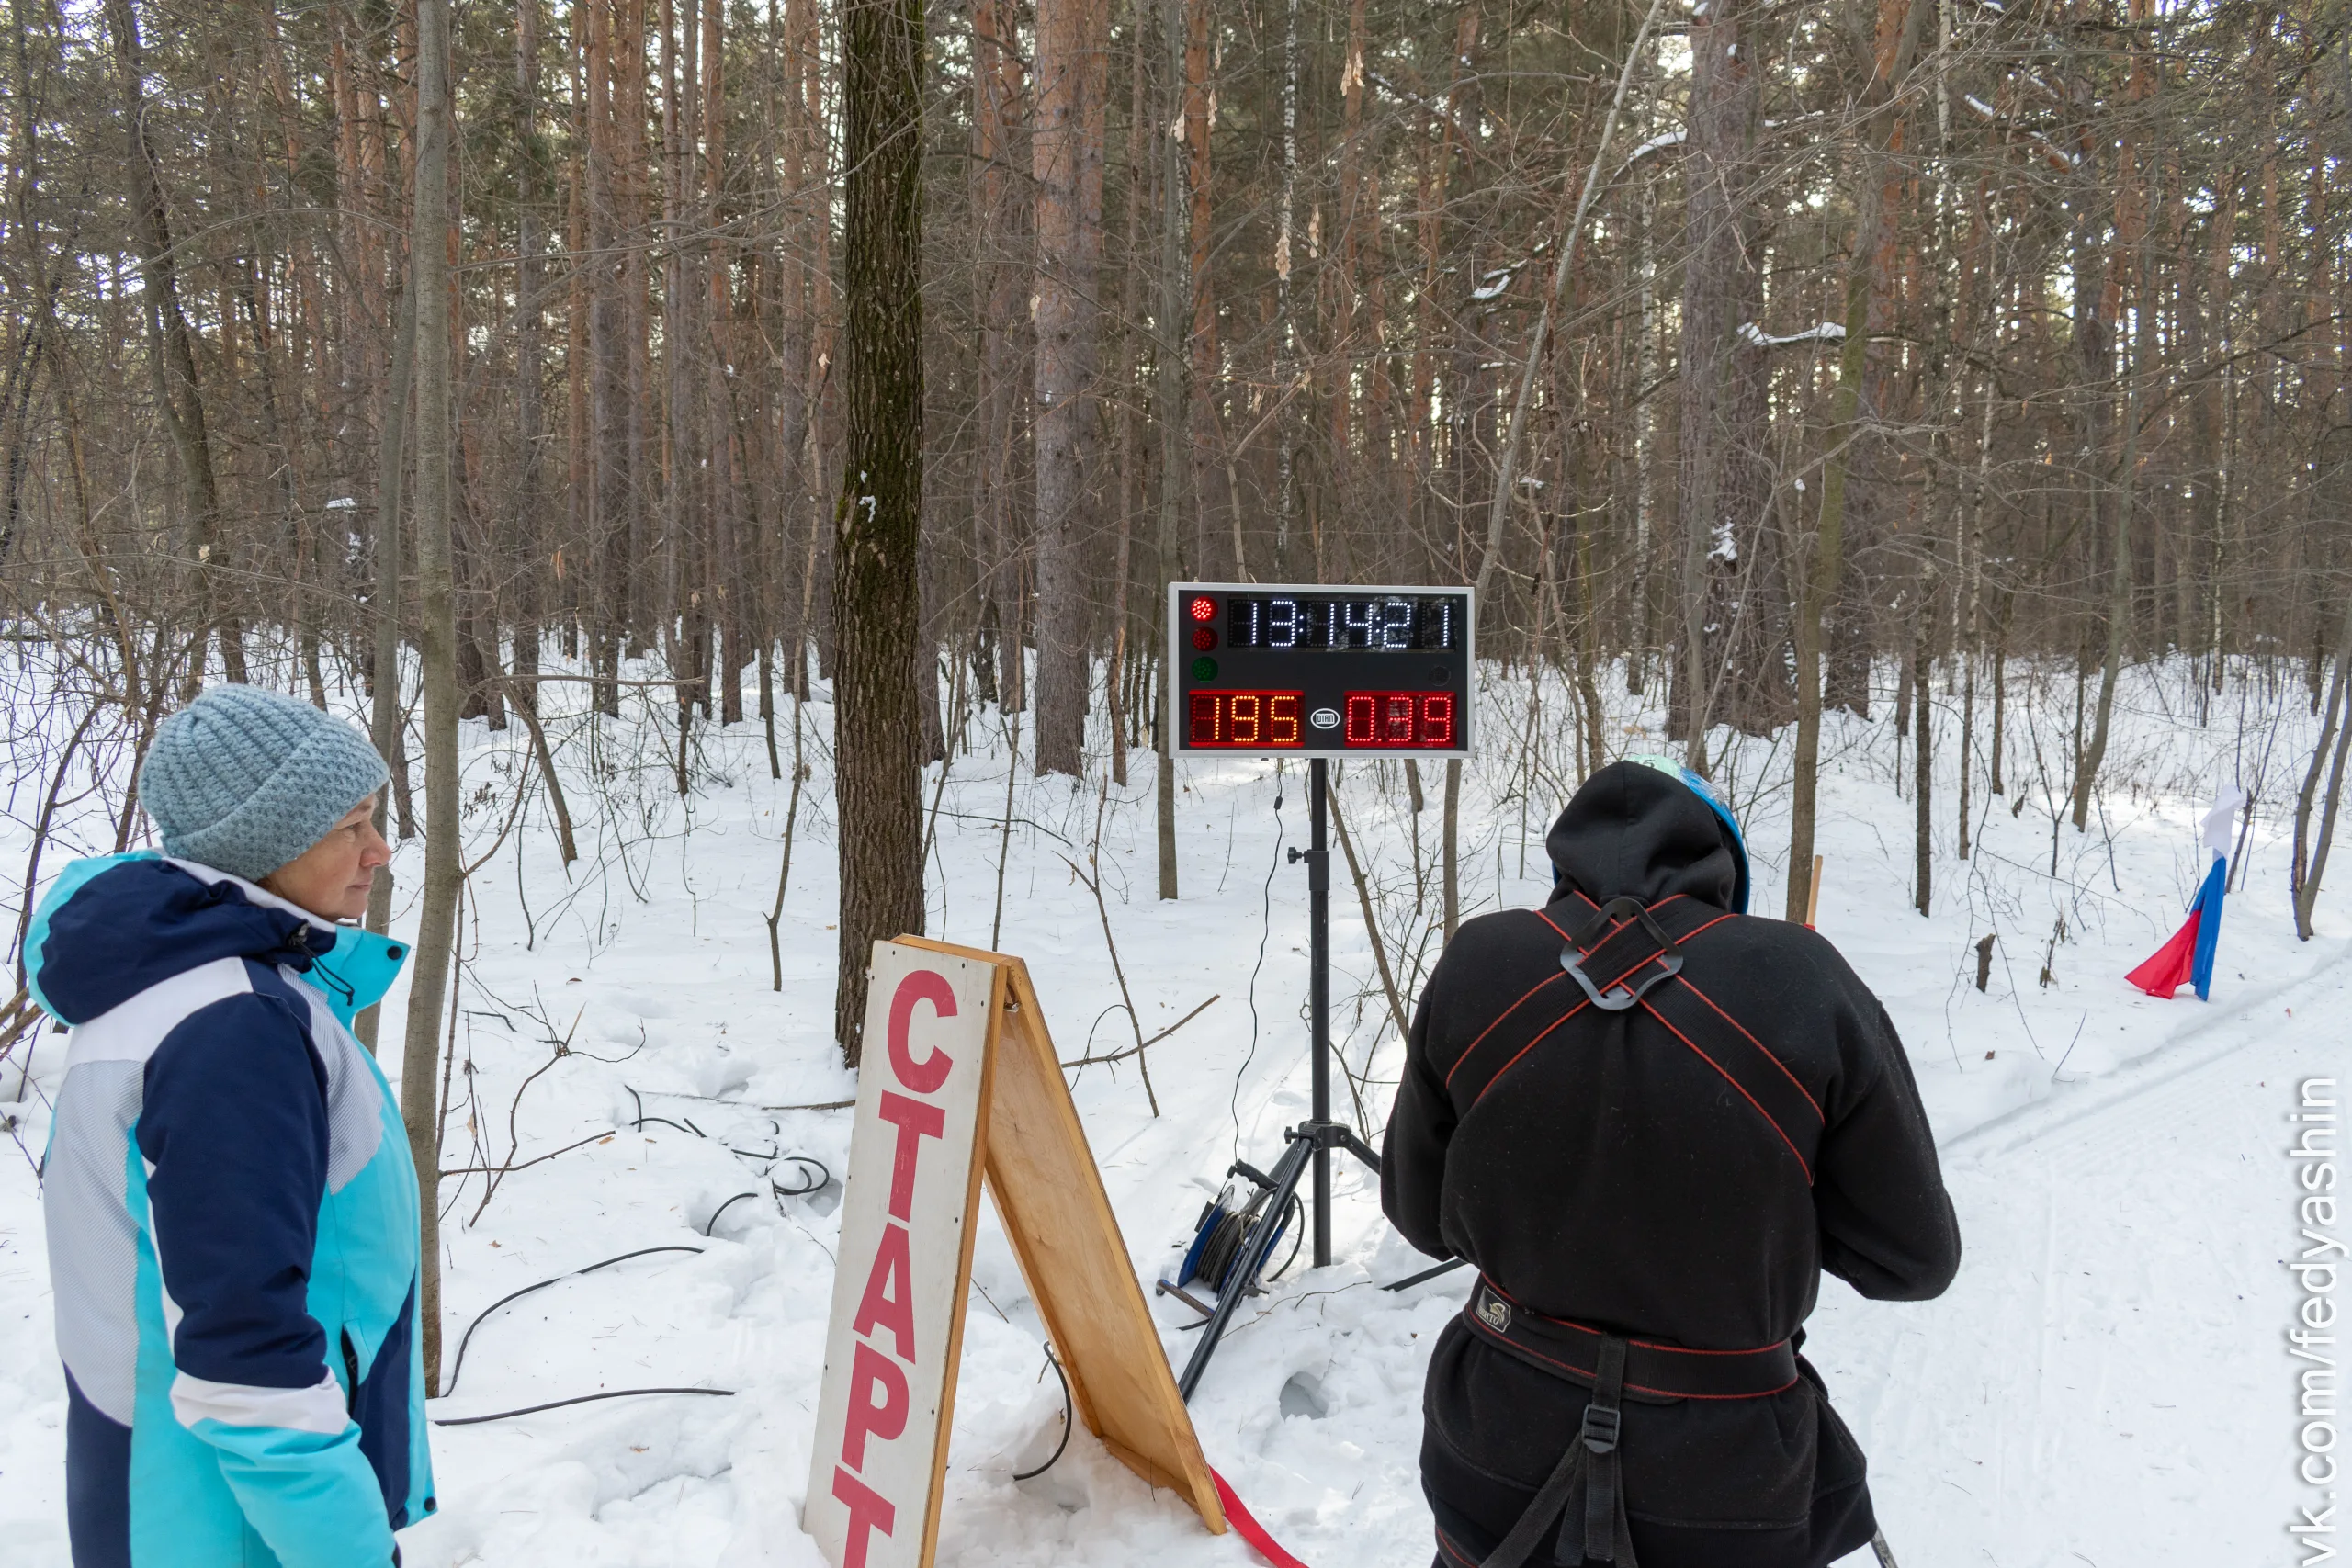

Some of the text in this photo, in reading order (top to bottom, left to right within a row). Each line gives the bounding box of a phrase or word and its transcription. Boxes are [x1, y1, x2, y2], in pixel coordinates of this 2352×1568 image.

[1252, 600, 1449, 649] 13:14:21
[1214, 695, 1297, 742] 195
[1347, 695, 1452, 742] 0.39
[832, 968, 958, 1568] СТАРТ
